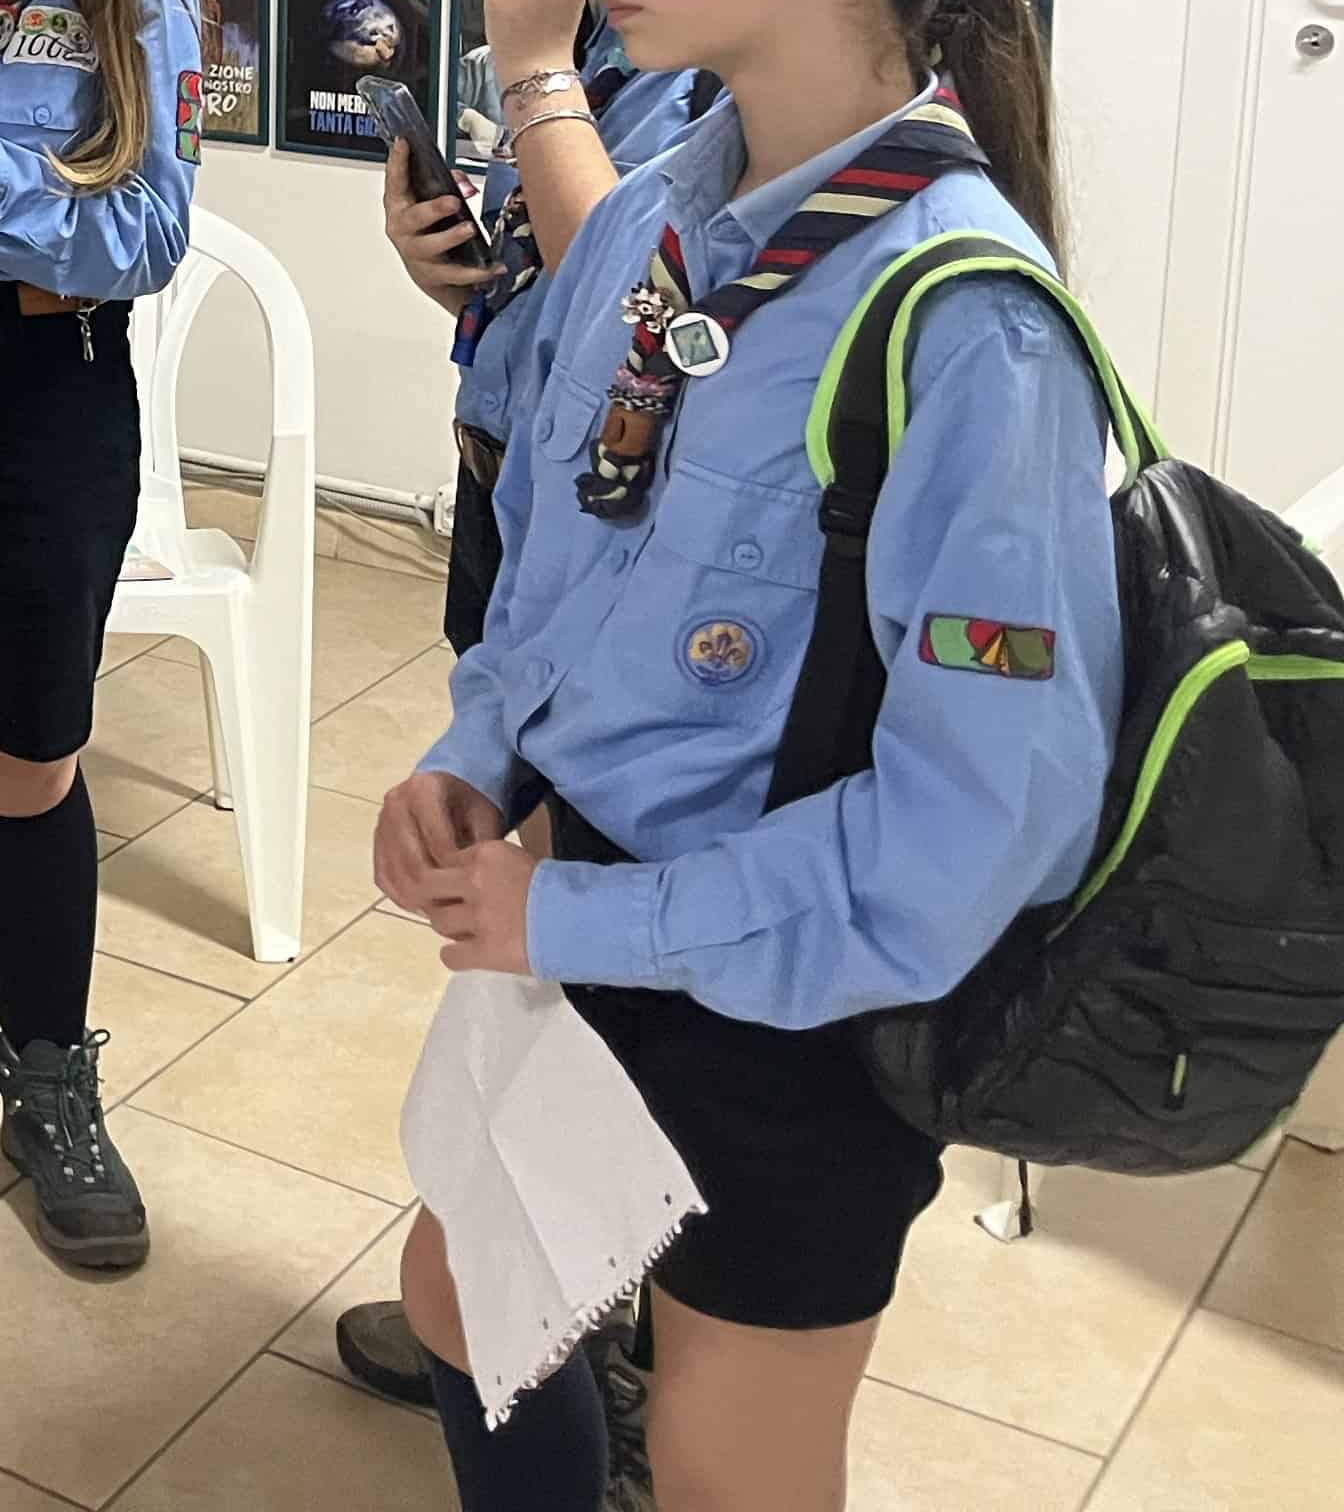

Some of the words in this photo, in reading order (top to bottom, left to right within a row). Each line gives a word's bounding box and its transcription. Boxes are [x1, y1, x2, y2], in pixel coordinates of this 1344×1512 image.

[310, 90, 336, 112] NON
[337, 93, 369, 115] MERI
[309, 110, 353, 135] TANTA
